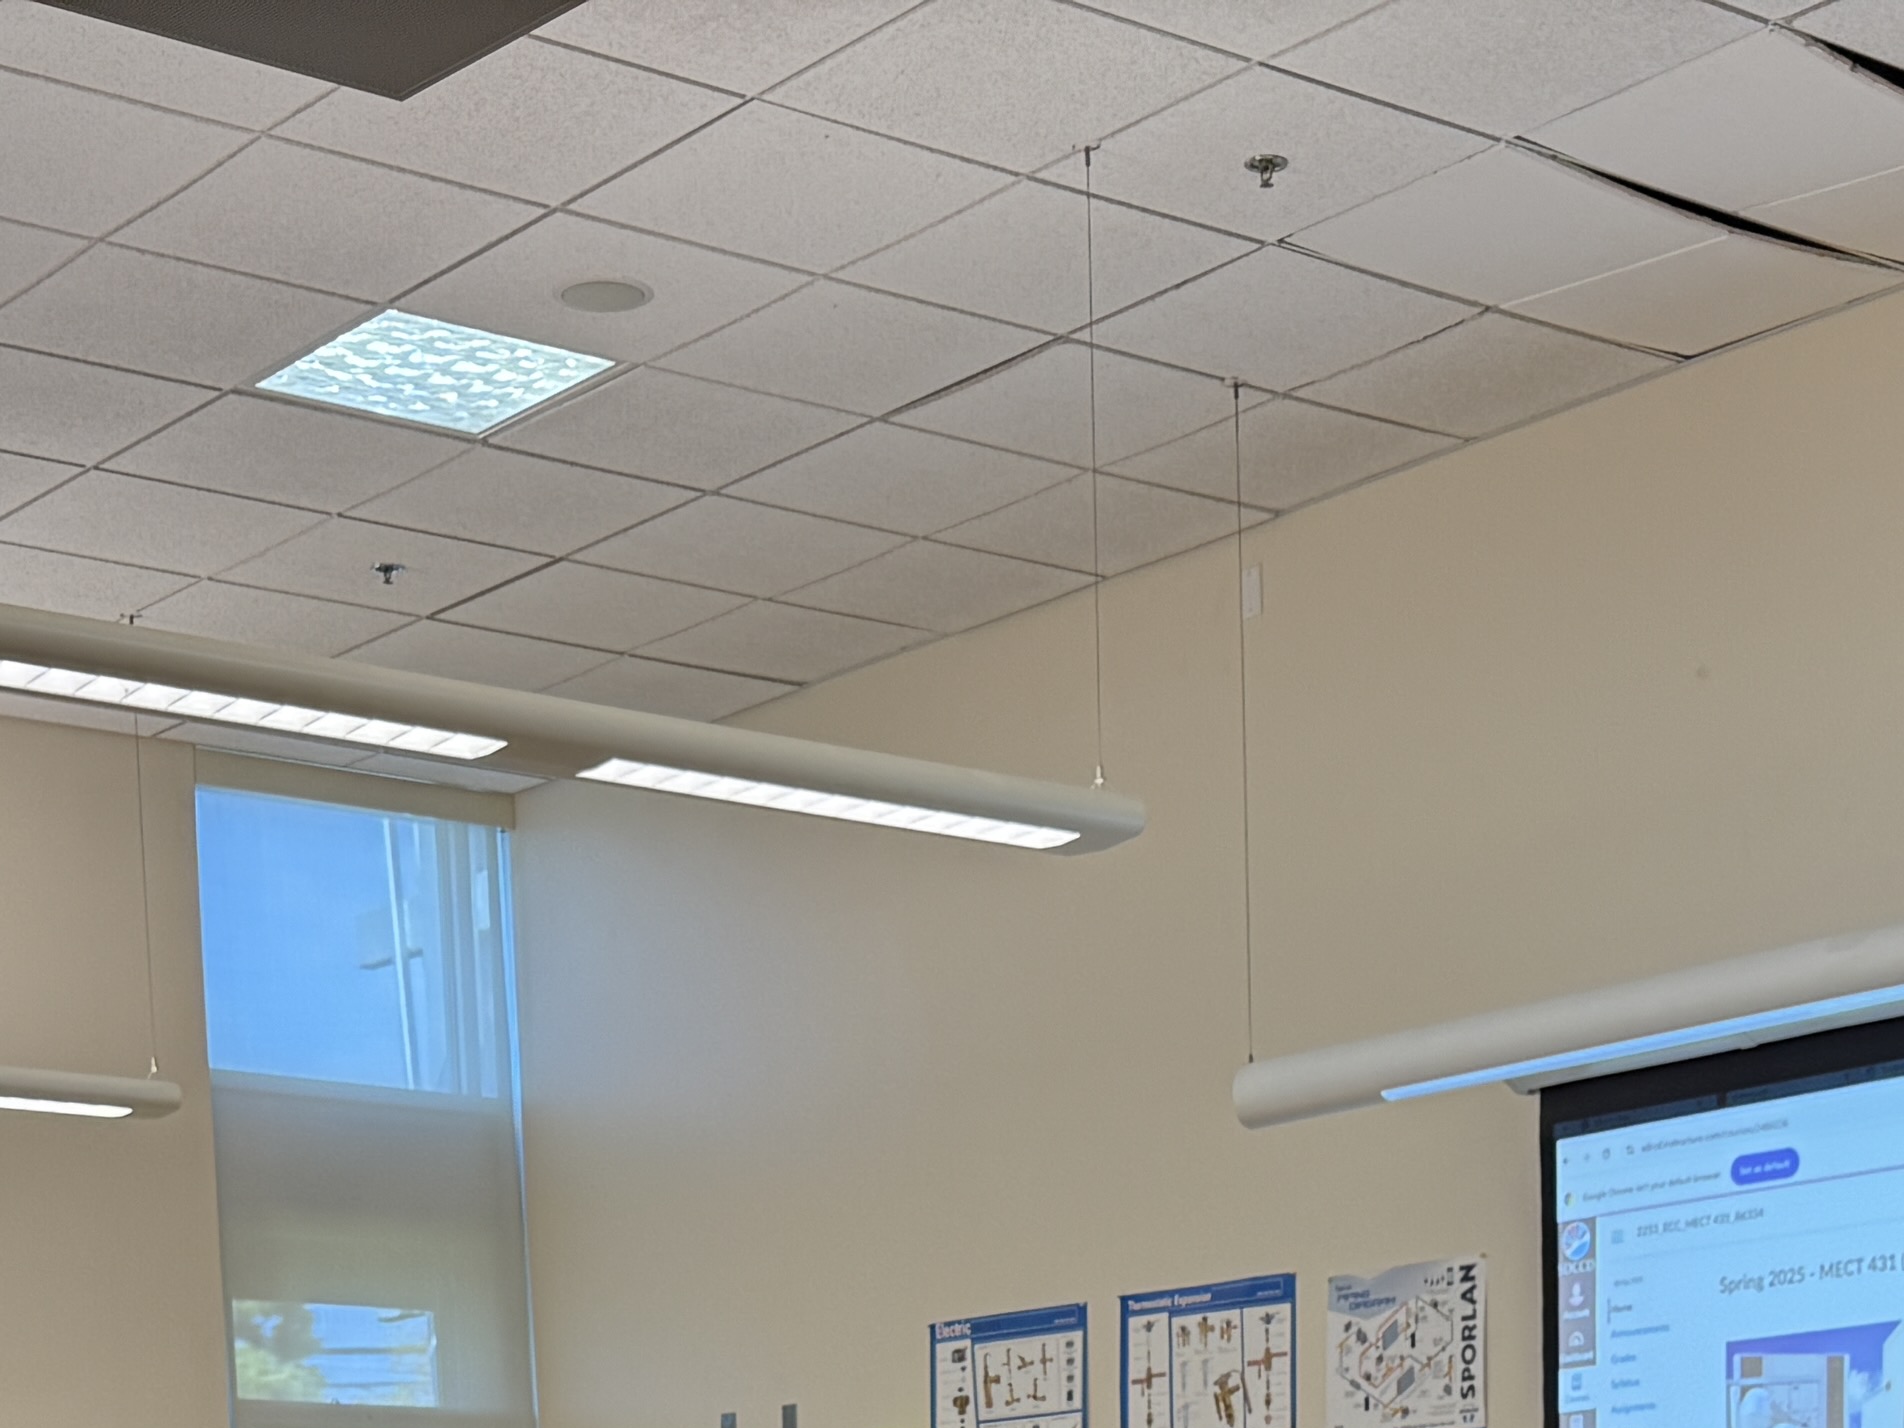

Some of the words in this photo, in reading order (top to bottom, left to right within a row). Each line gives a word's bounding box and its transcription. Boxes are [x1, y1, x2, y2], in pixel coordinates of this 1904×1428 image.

[1719, 1274, 1764, 1295] Spring
[1768, 1265, 1806, 1288] 2025
[1819, 1258, 1865, 1280] MECT
[1867, 1254, 1897, 1272] 431
[936, 1321, 971, 1339] Electric
[1459, 1263, 1478, 1400] SPORLAN
